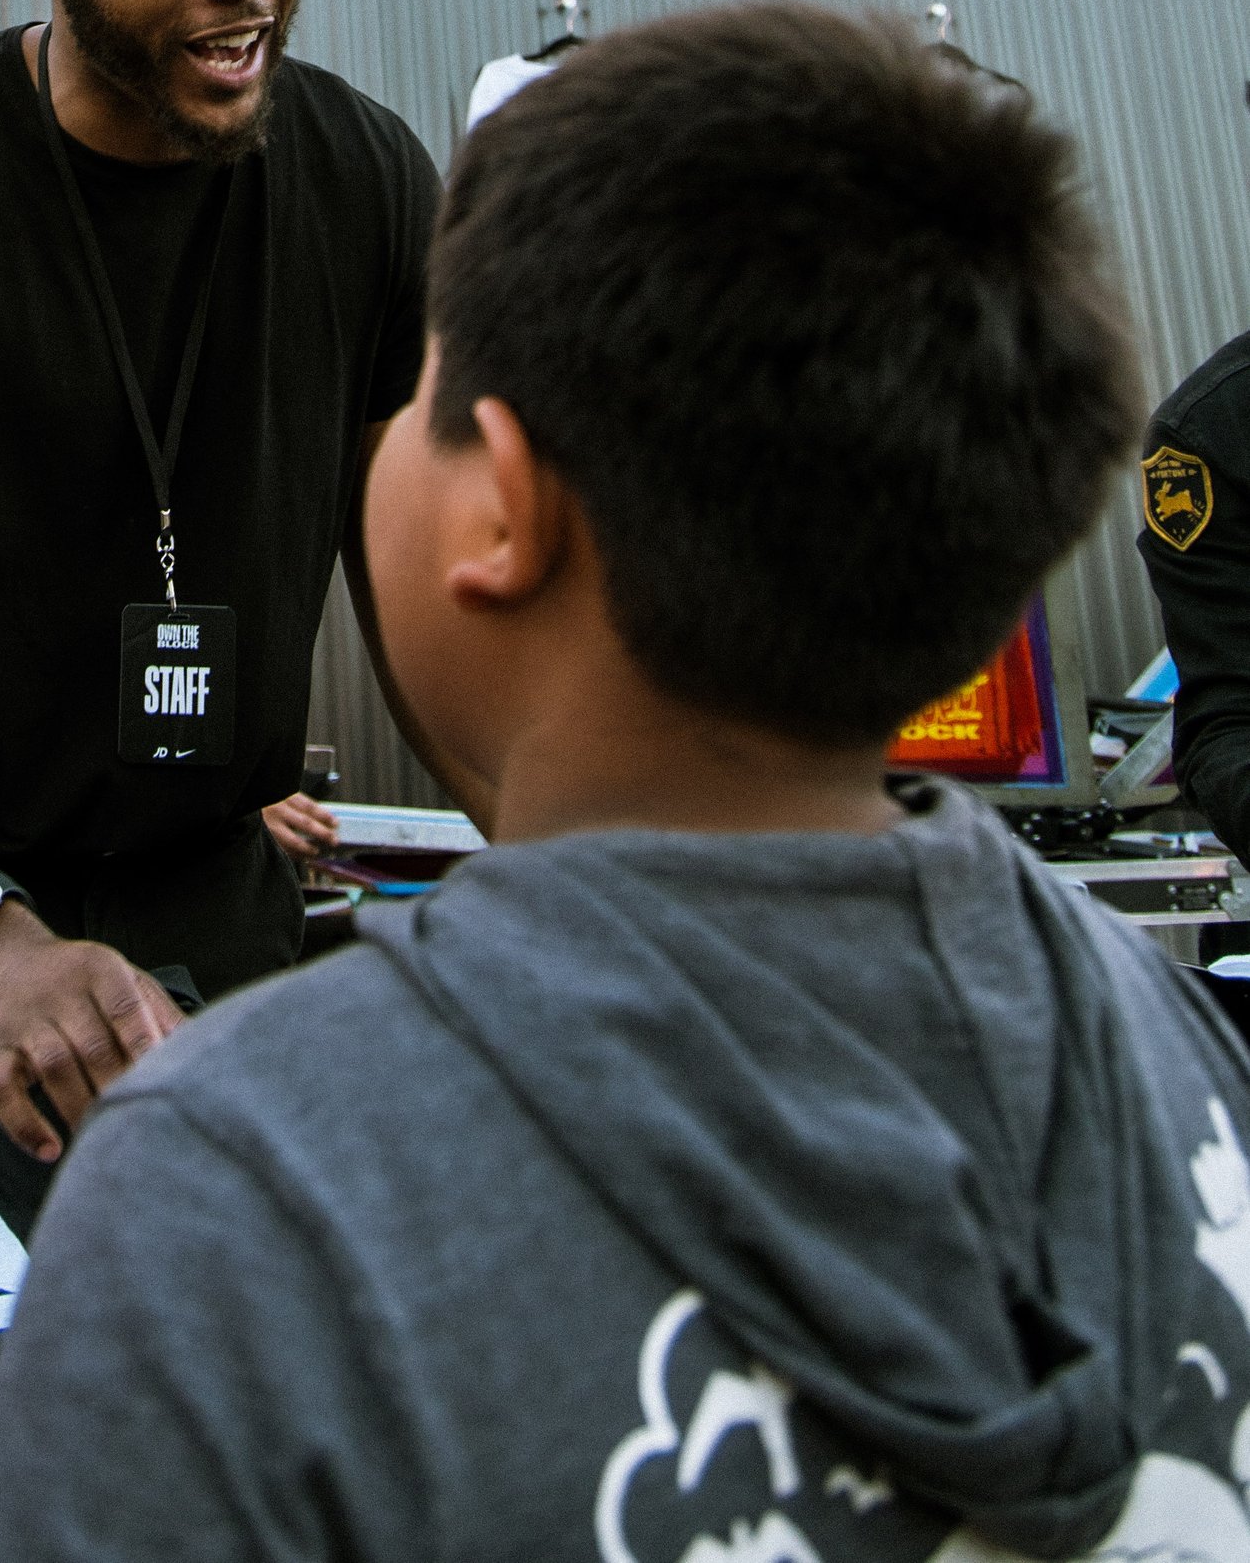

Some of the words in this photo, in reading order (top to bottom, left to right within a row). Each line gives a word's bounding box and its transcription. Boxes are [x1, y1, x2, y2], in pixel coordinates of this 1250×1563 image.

[157, 623, 181, 641] OWN
[182, 624, 200, 641] THE
[157, 639, 200, 650] BLOCK
[144, 665, 211, 716] STAFF
[900, 723, 981, 741] OCK
[152, 746, 169, 759] JD
